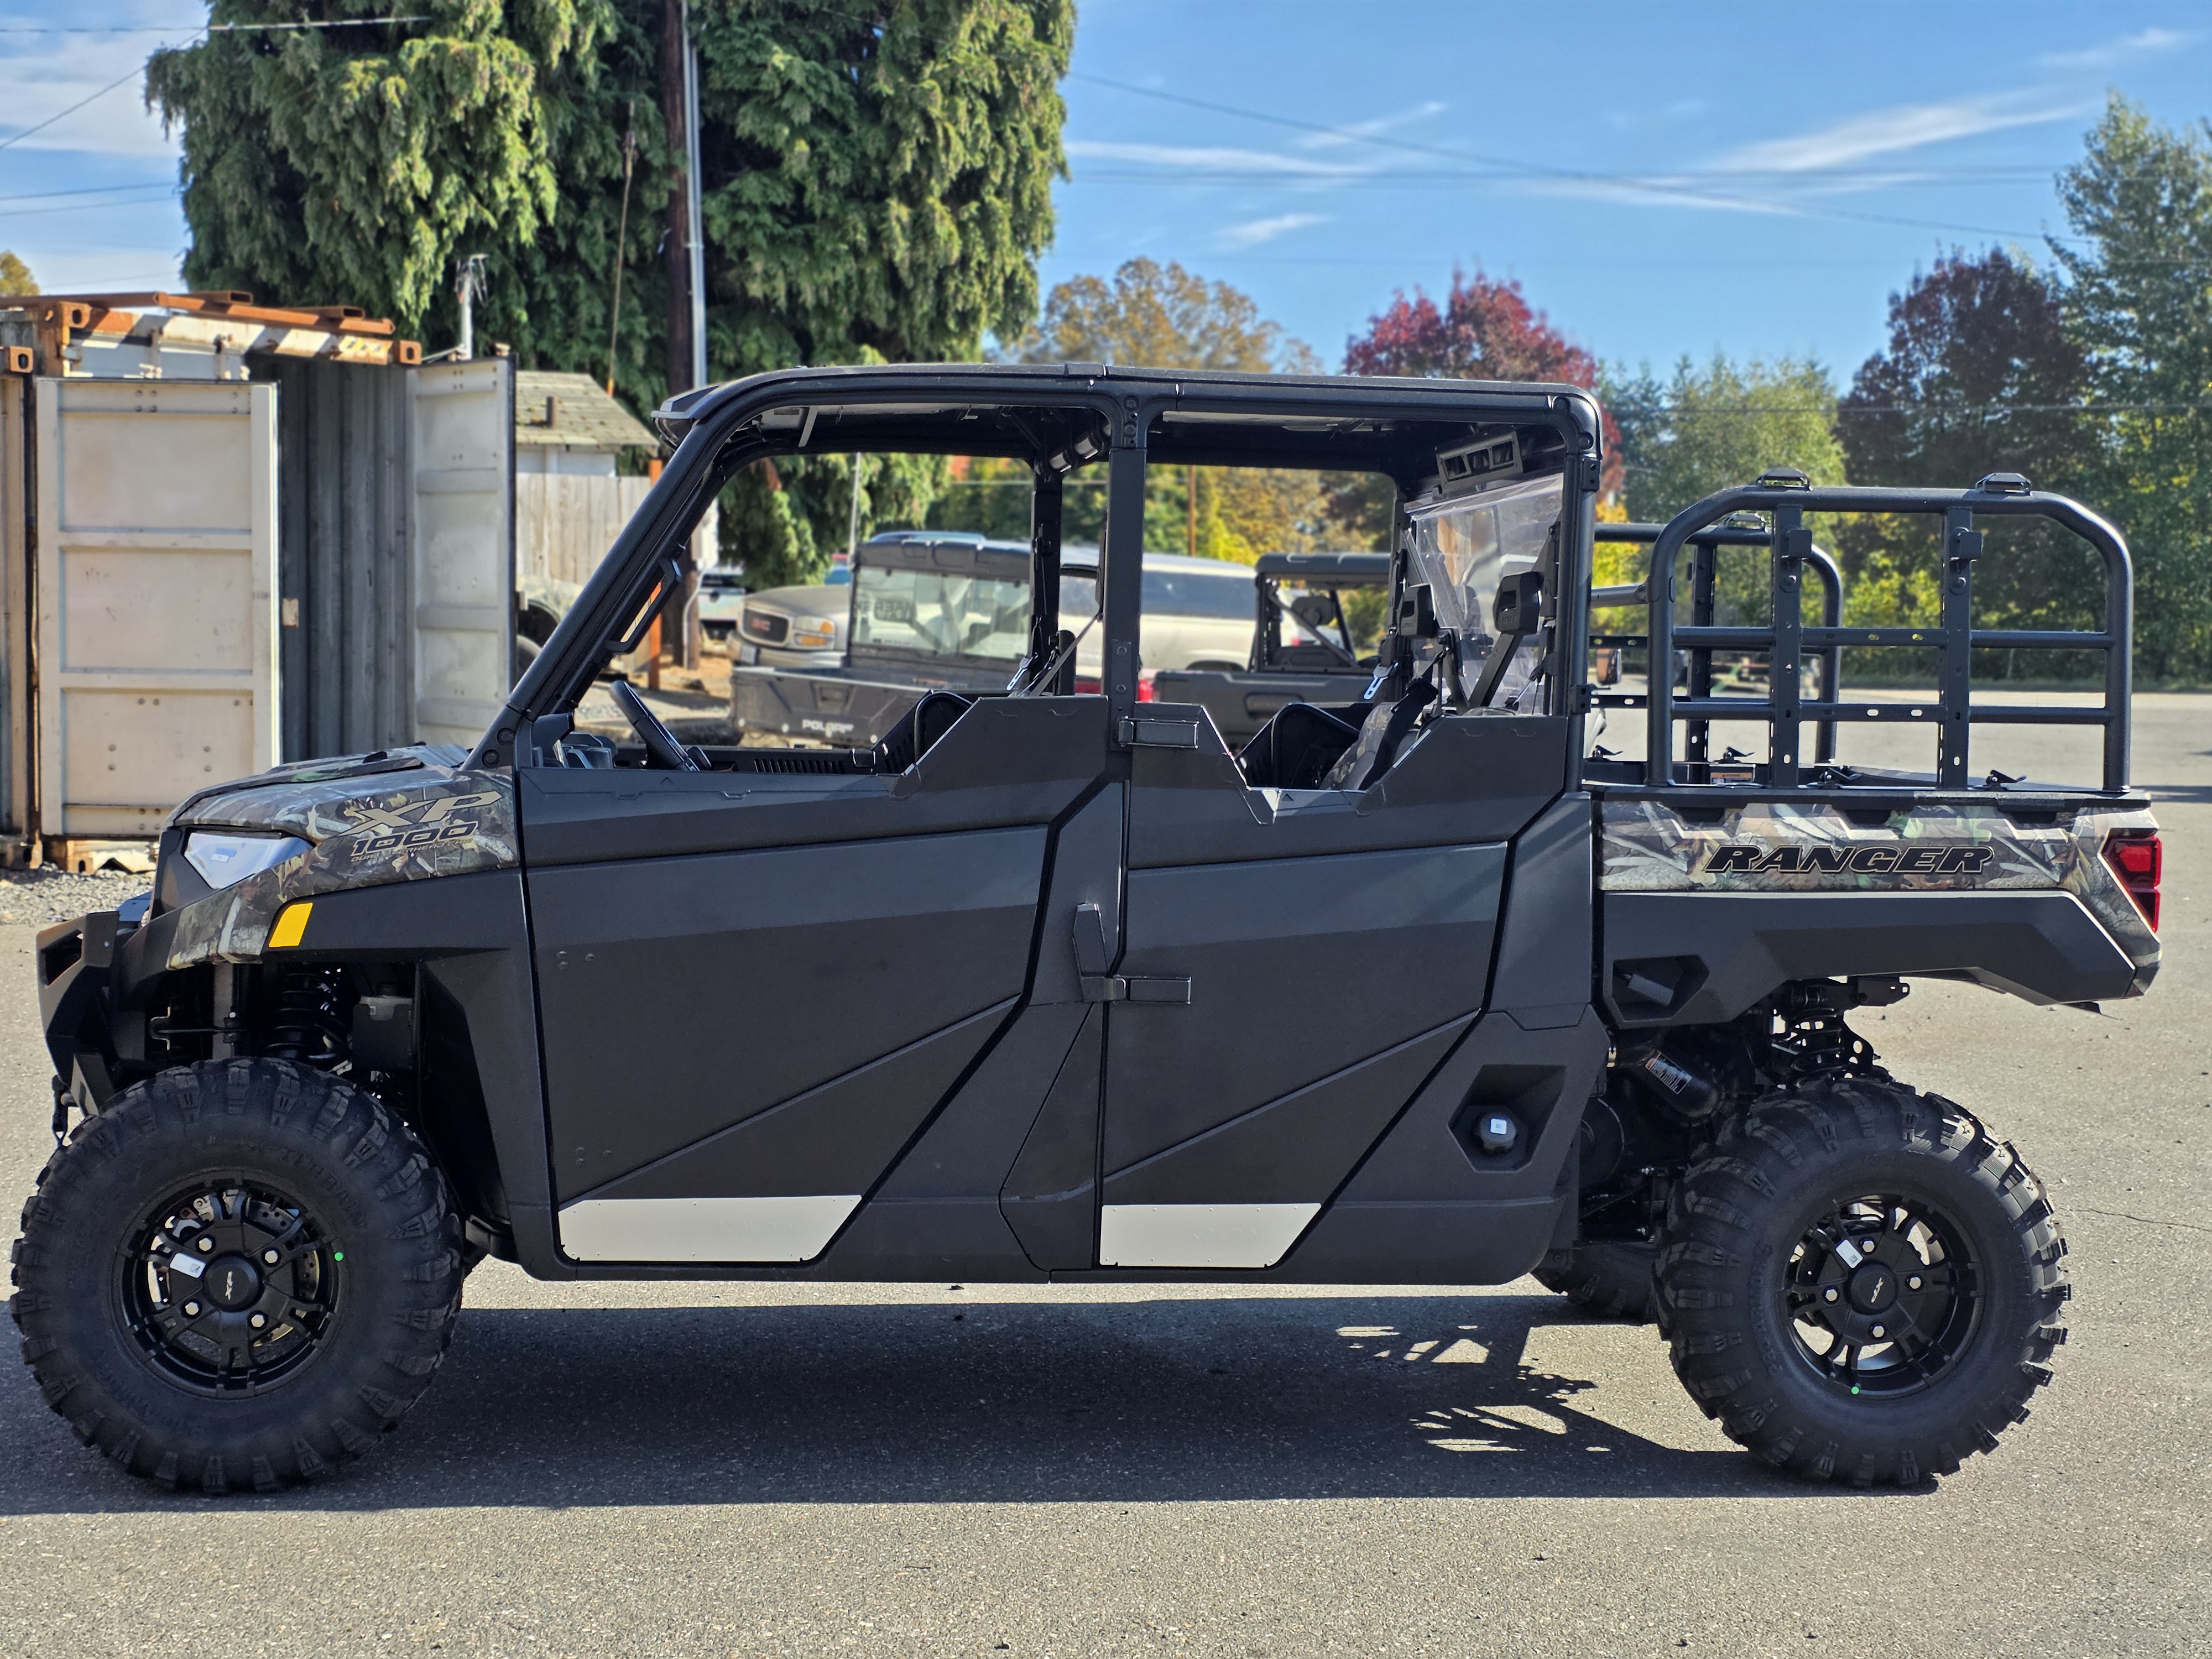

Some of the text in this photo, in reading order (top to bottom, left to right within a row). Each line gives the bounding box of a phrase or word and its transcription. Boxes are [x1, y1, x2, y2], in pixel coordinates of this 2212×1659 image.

[337, 791, 503, 837] XP
[350, 821, 478, 857] 1000
[1702, 844, 1995, 874] RANGER
